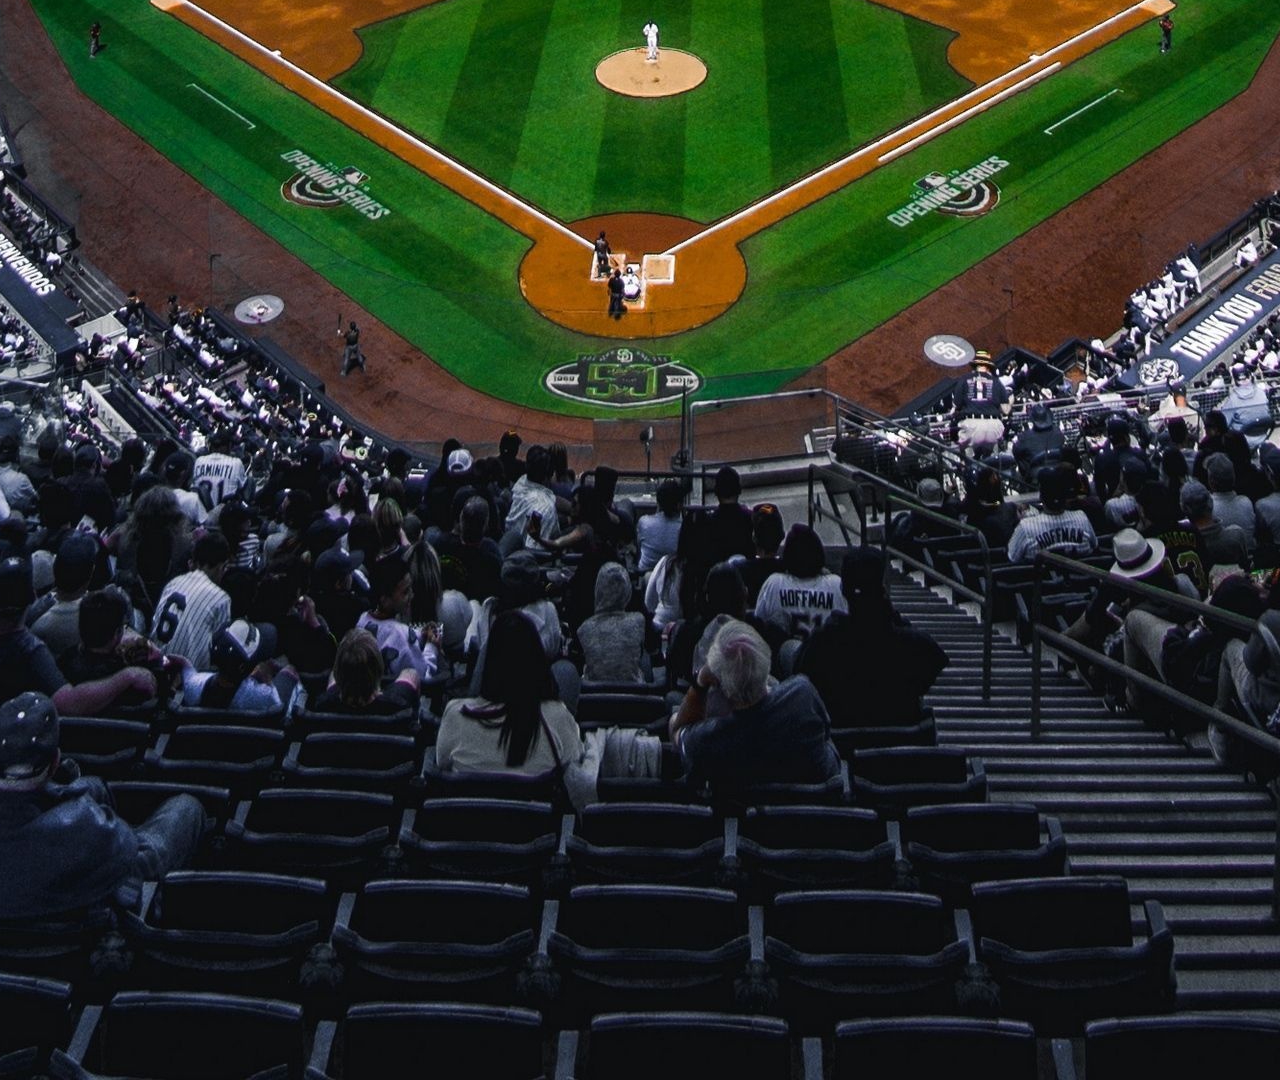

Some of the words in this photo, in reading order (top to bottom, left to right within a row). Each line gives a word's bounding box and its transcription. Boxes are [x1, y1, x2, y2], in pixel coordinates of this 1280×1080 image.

[280, 149, 346, 189] OPENING
[331, 184, 392, 220] SERIES
[886, 183, 962, 228] OPENING
[950, 155, 1011, 190] SERIES
[1170, 311, 1240, 362] THANK
[1220, 294, 1264, 326] YOU
[195, 464, 234, 481] CAMINITI
[1035, 527, 1084, 549] HOFFMAN
[154, 591, 188, 643] 6
[779, 589, 834, 610] HOFFMAN
